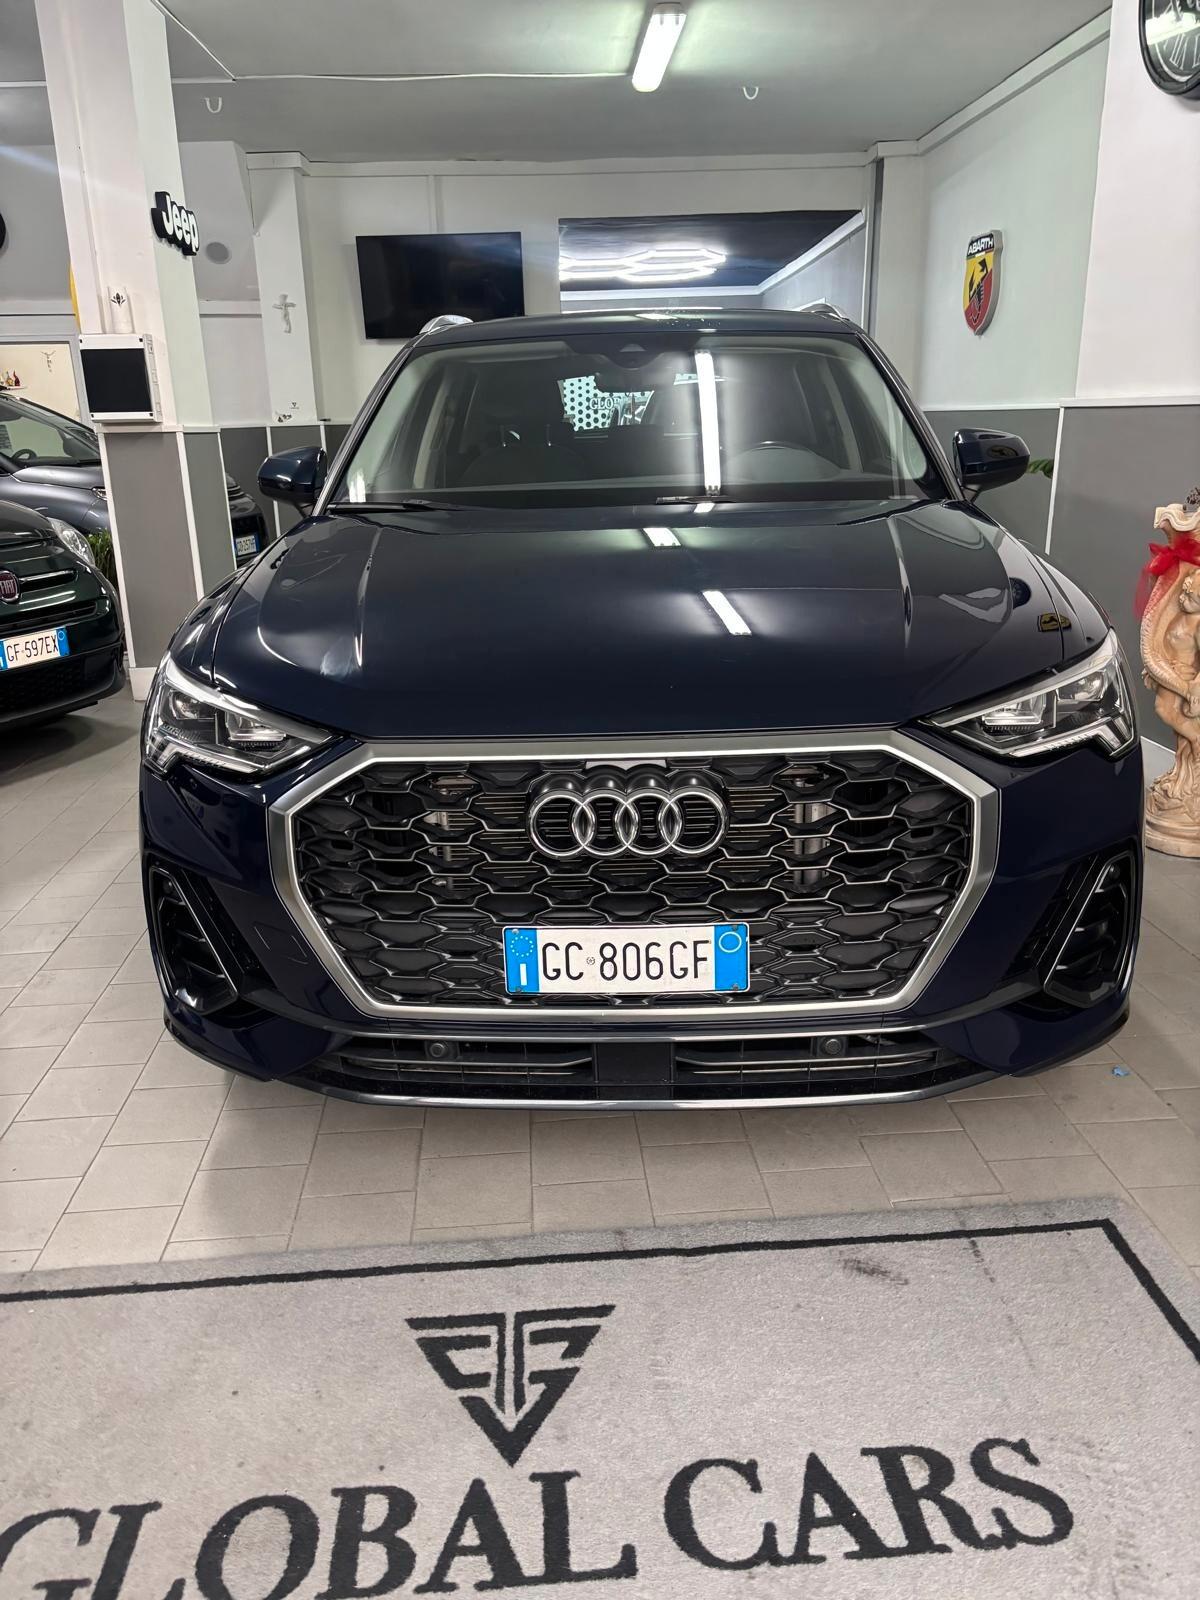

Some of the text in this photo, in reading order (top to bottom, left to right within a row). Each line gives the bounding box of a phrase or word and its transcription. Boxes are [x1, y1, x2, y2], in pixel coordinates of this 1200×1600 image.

[161, 193, 200, 253] Jeep
[967, 237, 994, 255] ABARTH
[0, 579, 15, 594] FIAT
[6, 643, 20, 662] GF
[24, 634, 59, 658] 597EX
[542, 940, 712, 981] GC 806GF
[0, 1437, 1074, 1600] GLOBAL CARS
